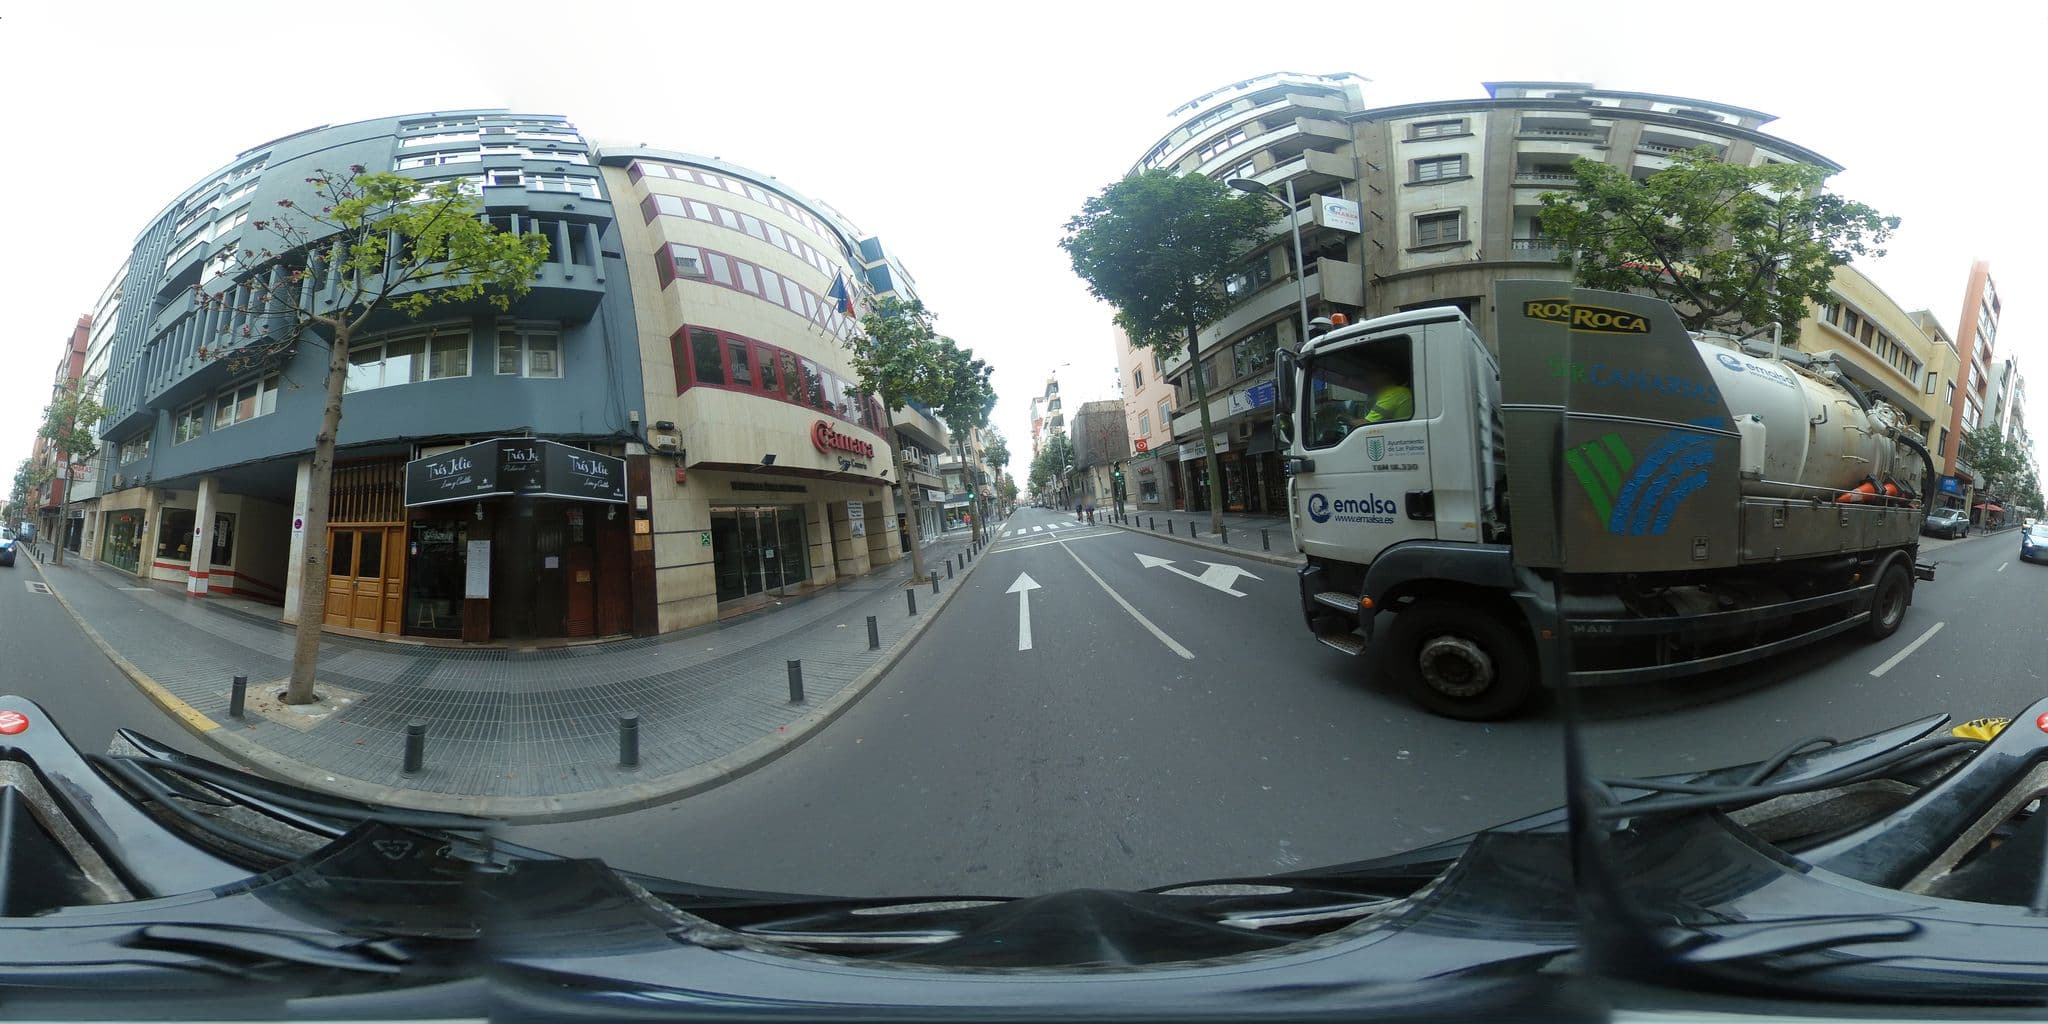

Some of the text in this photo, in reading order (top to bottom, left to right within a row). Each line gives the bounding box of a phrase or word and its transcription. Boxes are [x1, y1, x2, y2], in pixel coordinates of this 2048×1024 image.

[1573, 308, 1647, 332] ROCA
[1334, 493, 1396, 514] emalsa
[1335, 514, 1394, 525] www.emalsa.es
